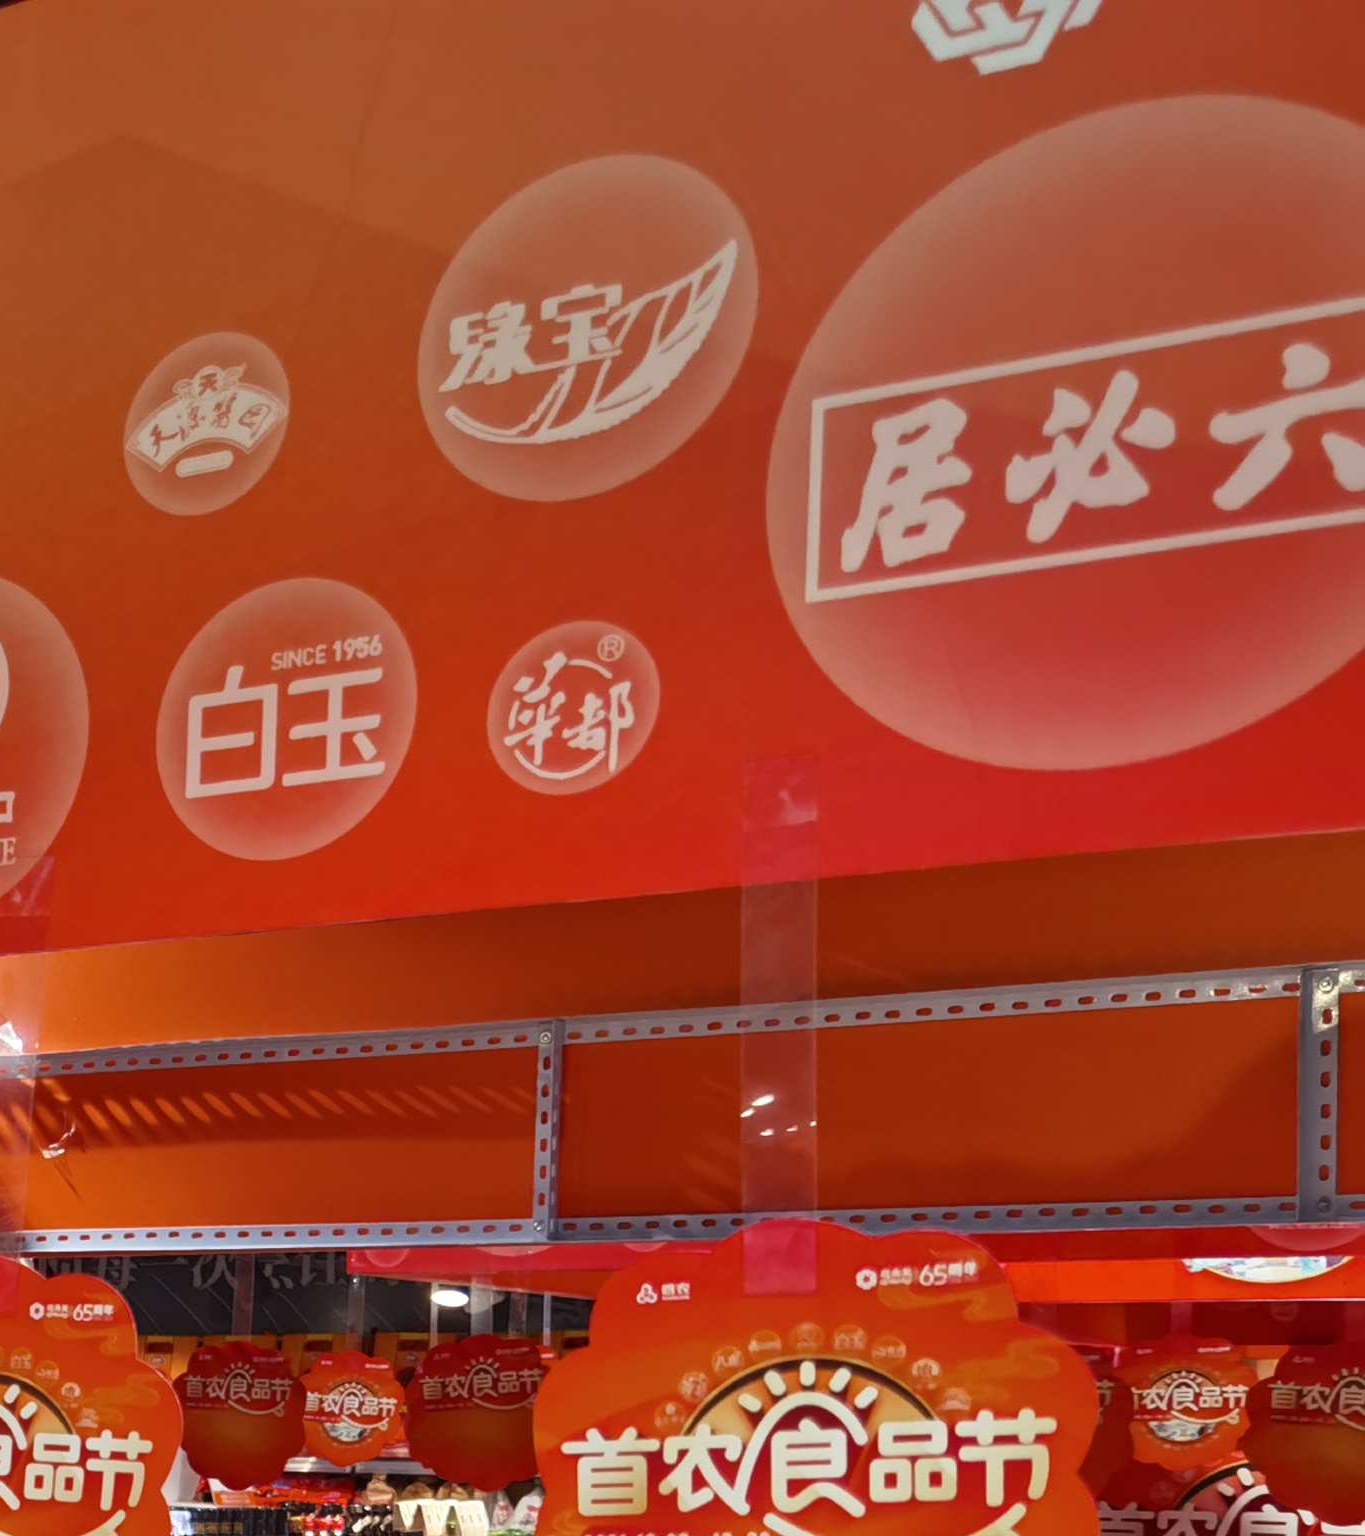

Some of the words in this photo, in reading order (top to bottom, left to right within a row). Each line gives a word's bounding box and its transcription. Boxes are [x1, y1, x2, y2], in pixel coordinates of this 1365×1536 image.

[270, 644, 328, 671] SINCE
[332, 634, 382, 663] 1956
[185, 664, 385, 800] 白玉
[185, 1369, 293, 1410] 首农食品节
[304, 1379, 397, 1417] 首农食品节
[419, 1366, 543, 1403] 首农食品节
[562, 1391, 1058, 1518] 首农食品节
